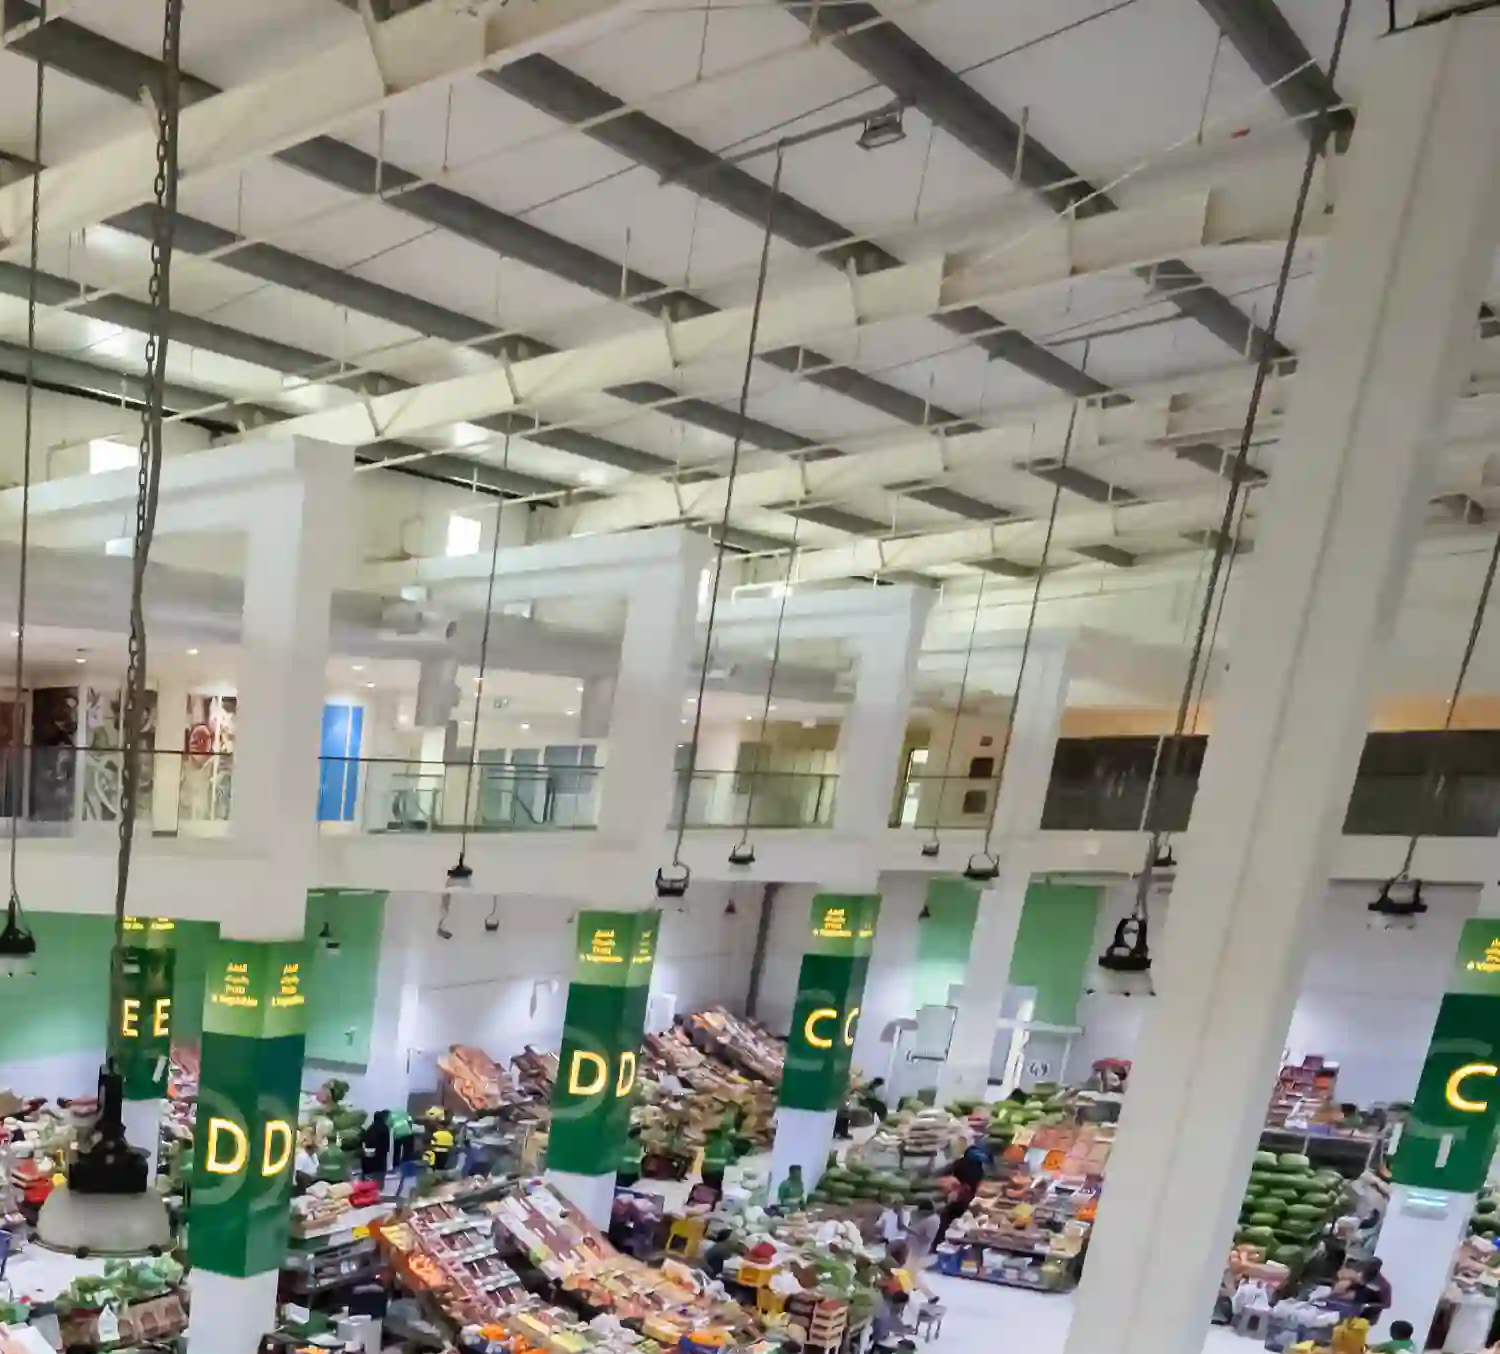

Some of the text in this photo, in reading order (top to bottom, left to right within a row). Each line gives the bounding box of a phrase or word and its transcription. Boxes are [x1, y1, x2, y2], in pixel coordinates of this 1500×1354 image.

[122, 999, 140, 1037] E
[153, 998, 171, 1037] E
[805, 1008, 837, 1048] C
[569, 1050, 607, 1096] D
[616, 1051, 636, 1097] D
[1446, 1062, 1498, 1112] C
[206, 1116, 248, 1174] D
[262, 1120, 292, 1177] D
